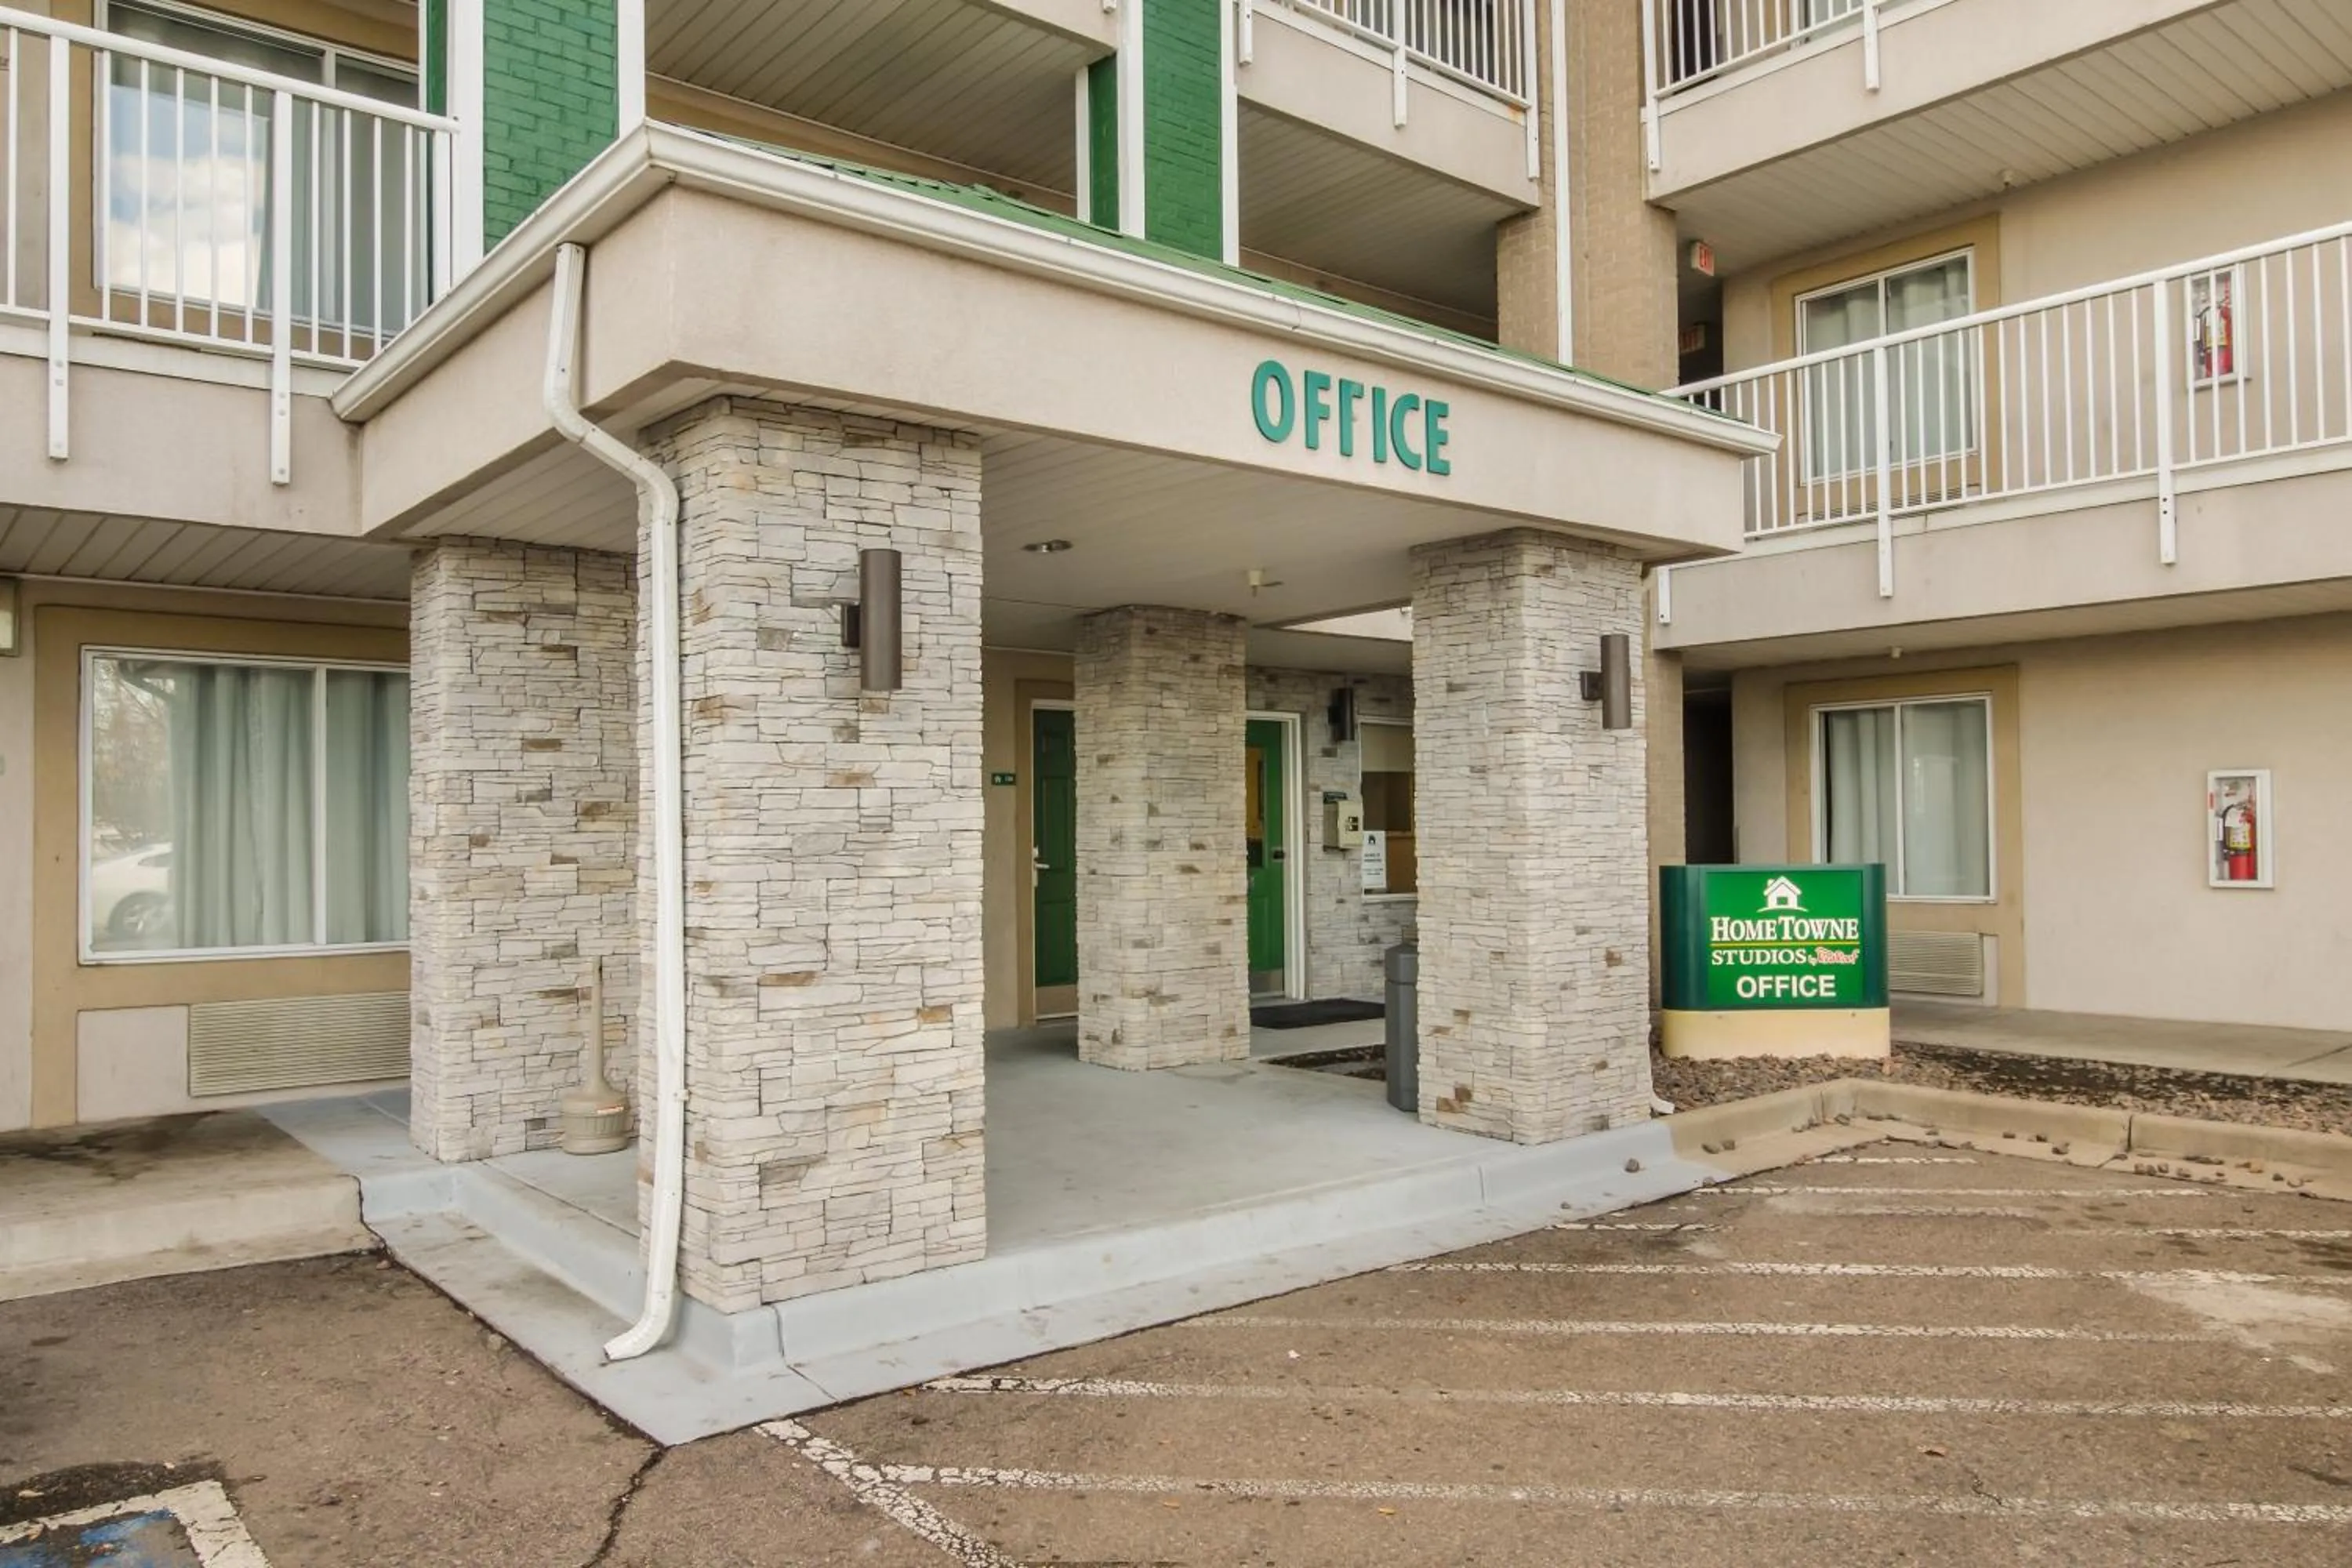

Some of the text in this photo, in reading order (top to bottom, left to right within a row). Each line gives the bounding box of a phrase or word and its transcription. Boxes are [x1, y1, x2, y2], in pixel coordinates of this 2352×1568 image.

[1251, 360, 1450, 476] OFFICE
[1711, 949, 1806, 965] STUDIOS
[1737, 975, 1836, 998] OFFICE
